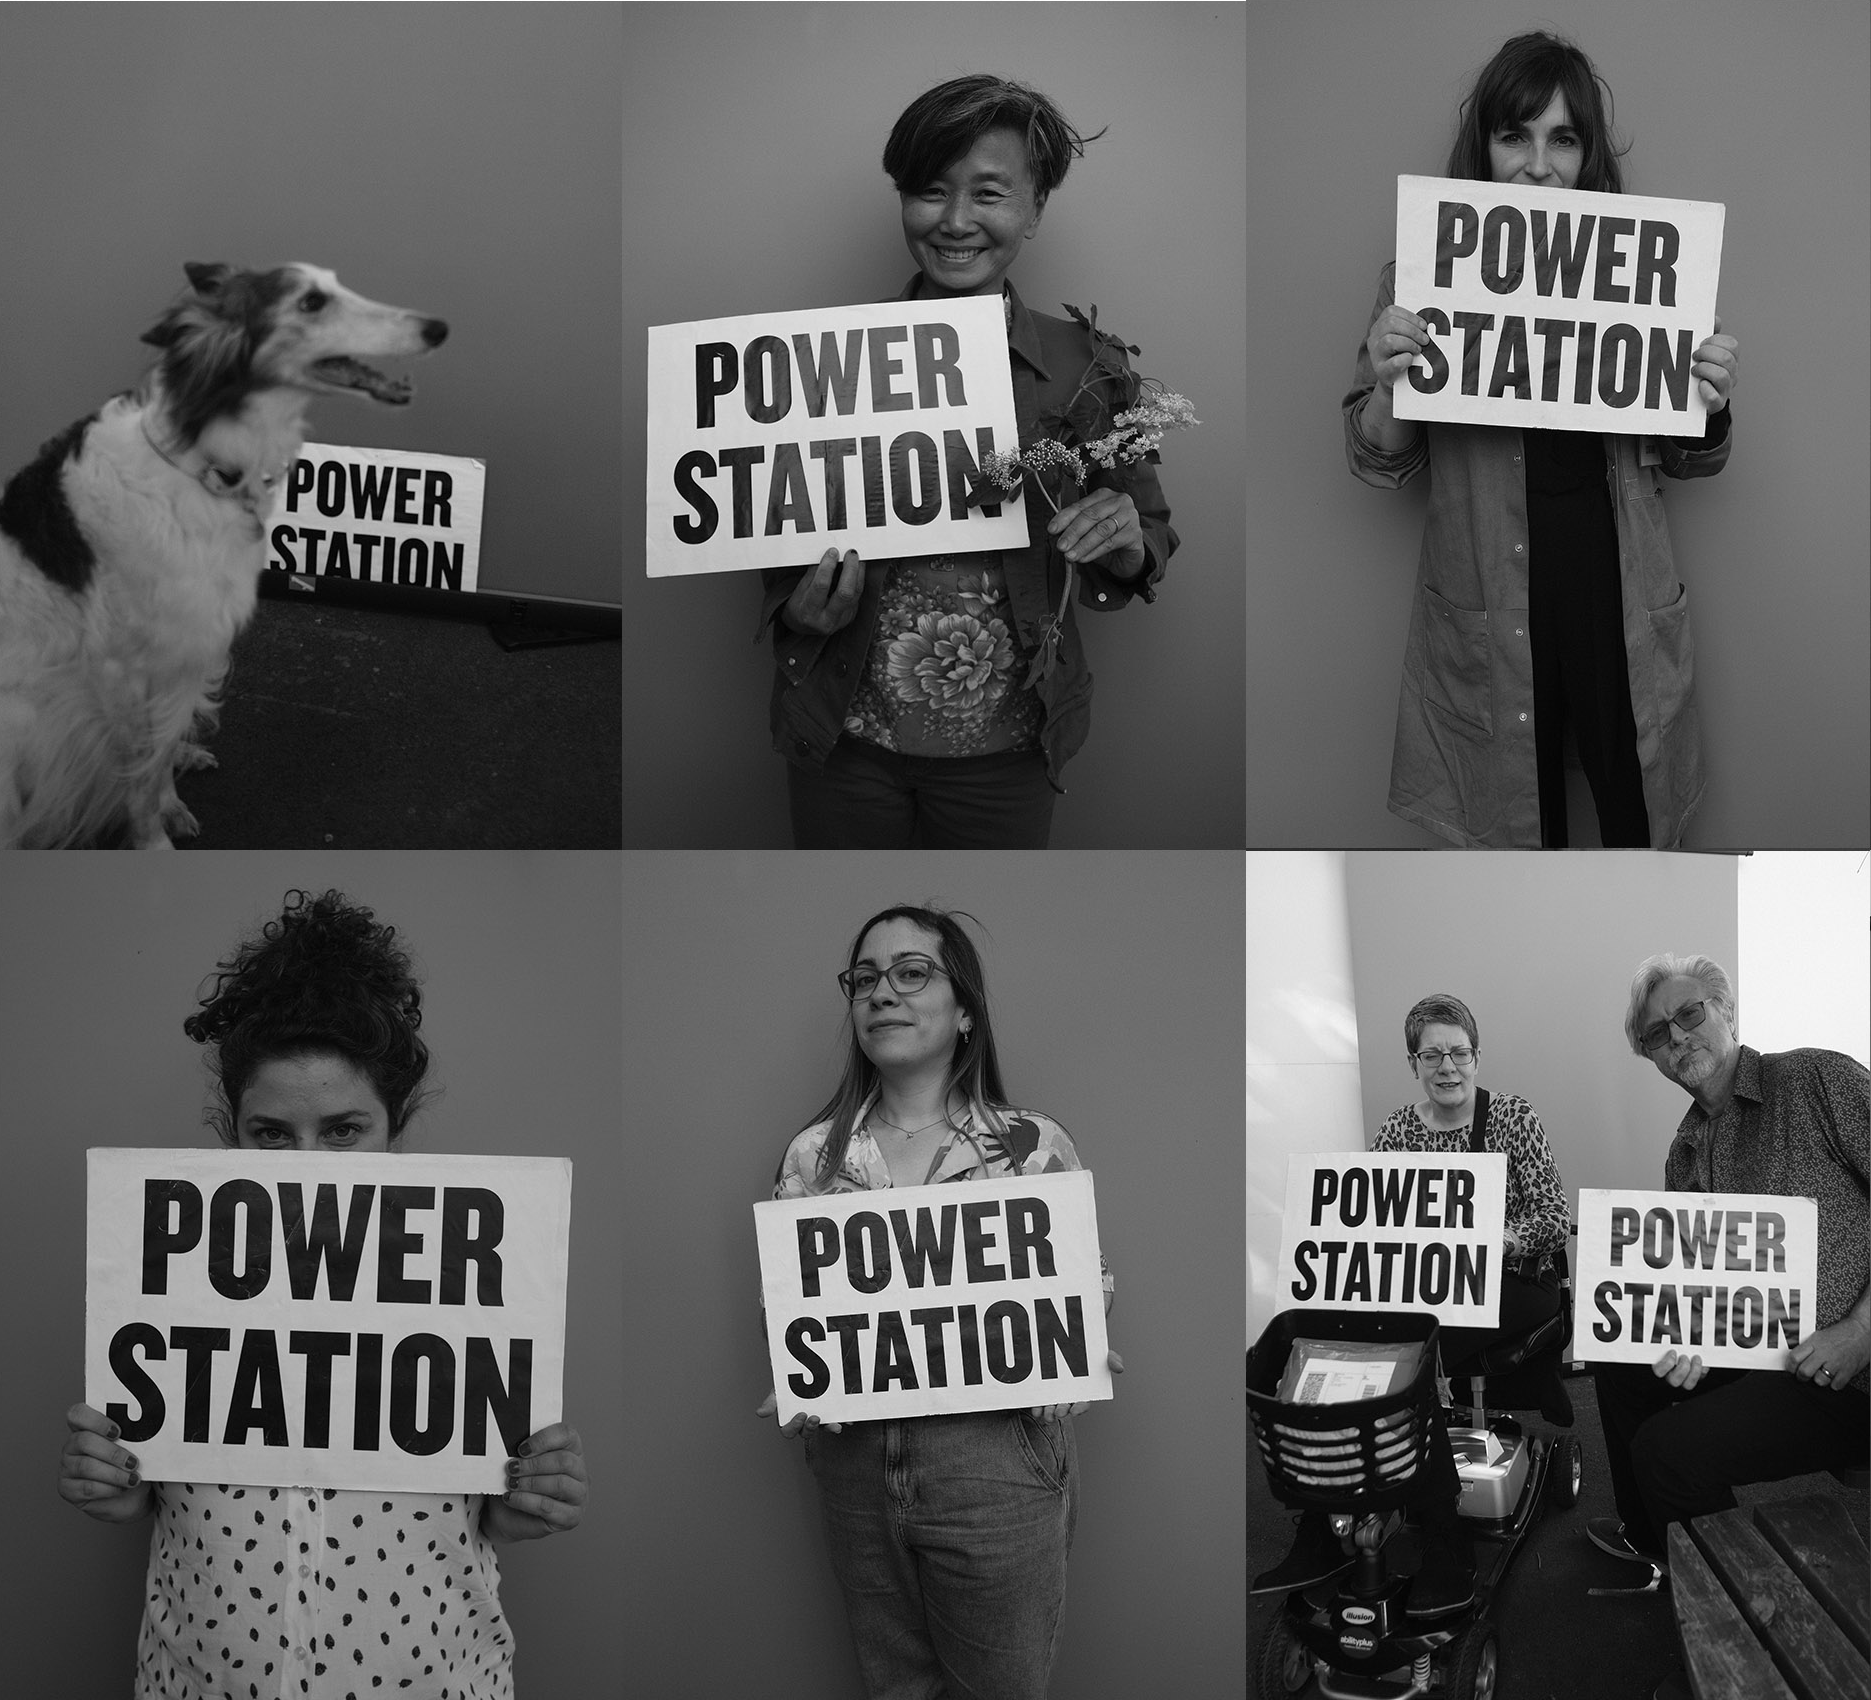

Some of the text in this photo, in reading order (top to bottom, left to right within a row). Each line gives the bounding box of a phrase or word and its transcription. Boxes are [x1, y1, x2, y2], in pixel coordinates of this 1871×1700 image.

[1435, 201, 1679, 307] POWER
[696, 323, 967, 429] POWER
[1407, 306, 1693, 411] STATION
[286, 459, 452, 528] POWER
[673, 427, 1002, 544] STATION
[270, 524, 465, 590] STATION
[142, 1179, 504, 1306] POWER
[796, 1198, 1057, 1298] POWER
[1311, 1168, 1475, 1228] POWER
[1611, 1207, 1786, 1272] POWER
[1292, 1240, 1487, 1305] STATION
[1593, 1281, 1803, 1349] STATION
[106, 1321, 533, 1456] STATION
[785, 1296, 1089, 1399] STATION
[1346, 1612, 1373, 1621] illusion
